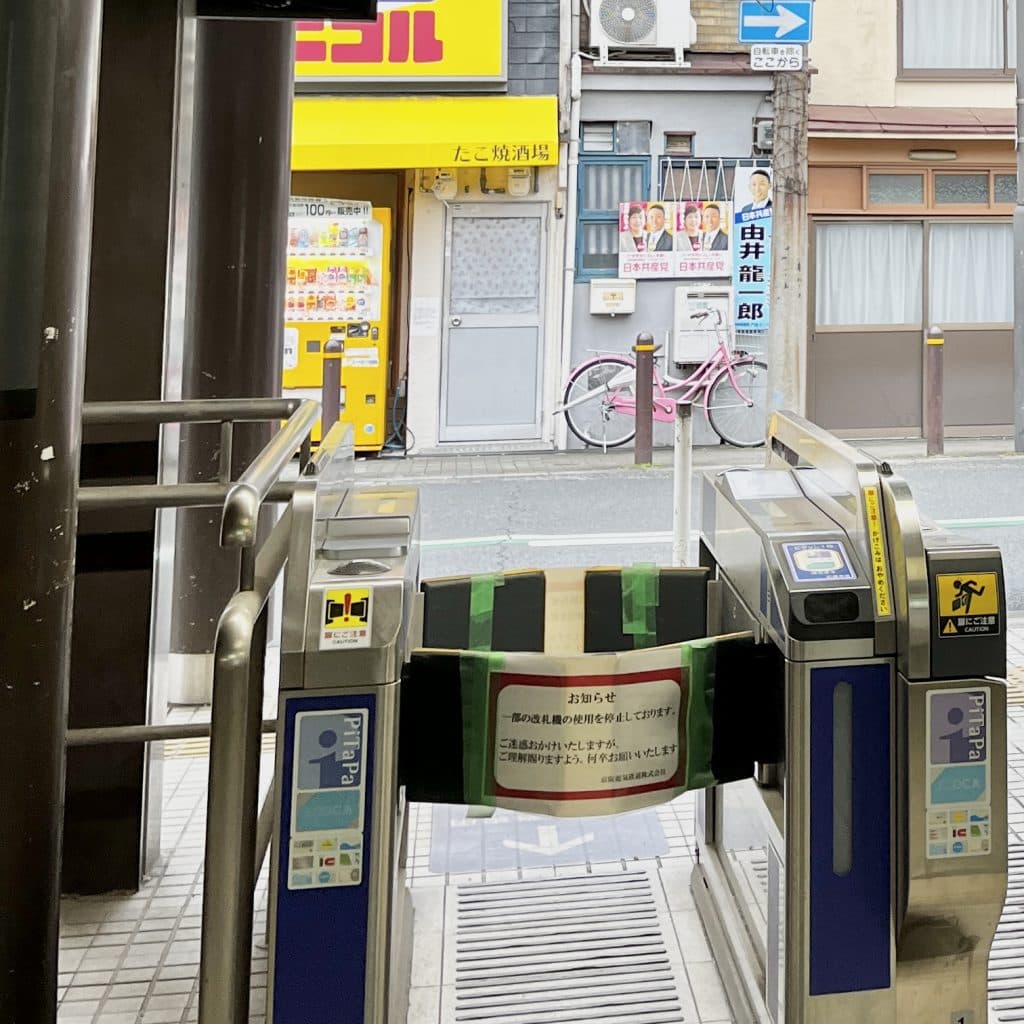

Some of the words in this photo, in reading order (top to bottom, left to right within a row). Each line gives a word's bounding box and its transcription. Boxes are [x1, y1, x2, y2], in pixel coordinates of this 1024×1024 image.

[753, 57, 800, 68] ここから
[453, 144, 549, 162] たこ焼酒場
[623, 262, 669, 272] 日本共産党
[679, 262, 724, 272] 日本共産党
[737, 223, 765, 321] 由井龍一郎
[567, 692, 617, 705] お知らせ
[503, 706, 676, 725] 一部の改札機の使用を停止しております。
[969, 693, 986, 761] PiTaPa
[341, 716, 361, 786] PiTaPa
